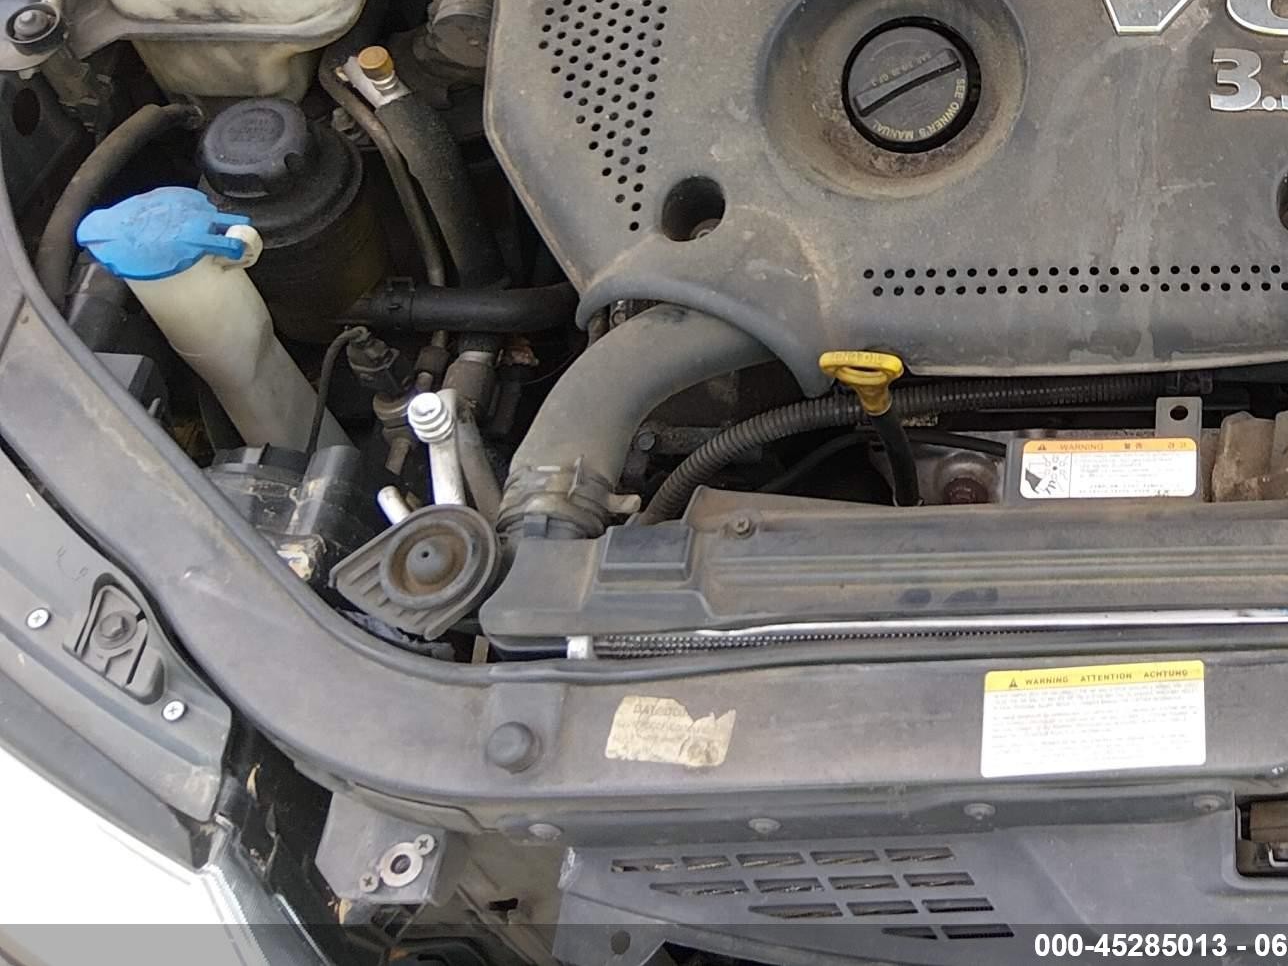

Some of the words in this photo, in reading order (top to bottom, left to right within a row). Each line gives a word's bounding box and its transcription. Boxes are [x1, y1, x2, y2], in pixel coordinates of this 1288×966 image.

[953, 78, 966, 100] SEE
[918, 105, 960, 137] OWNER'S
[1059, 442, 1104, 451] WARNING
[1025, 676, 1069, 686] WARNING
[1080, 672, 1133, 683] ATTENTION
[1143, 669, 1189, 679] ACHTUNG
